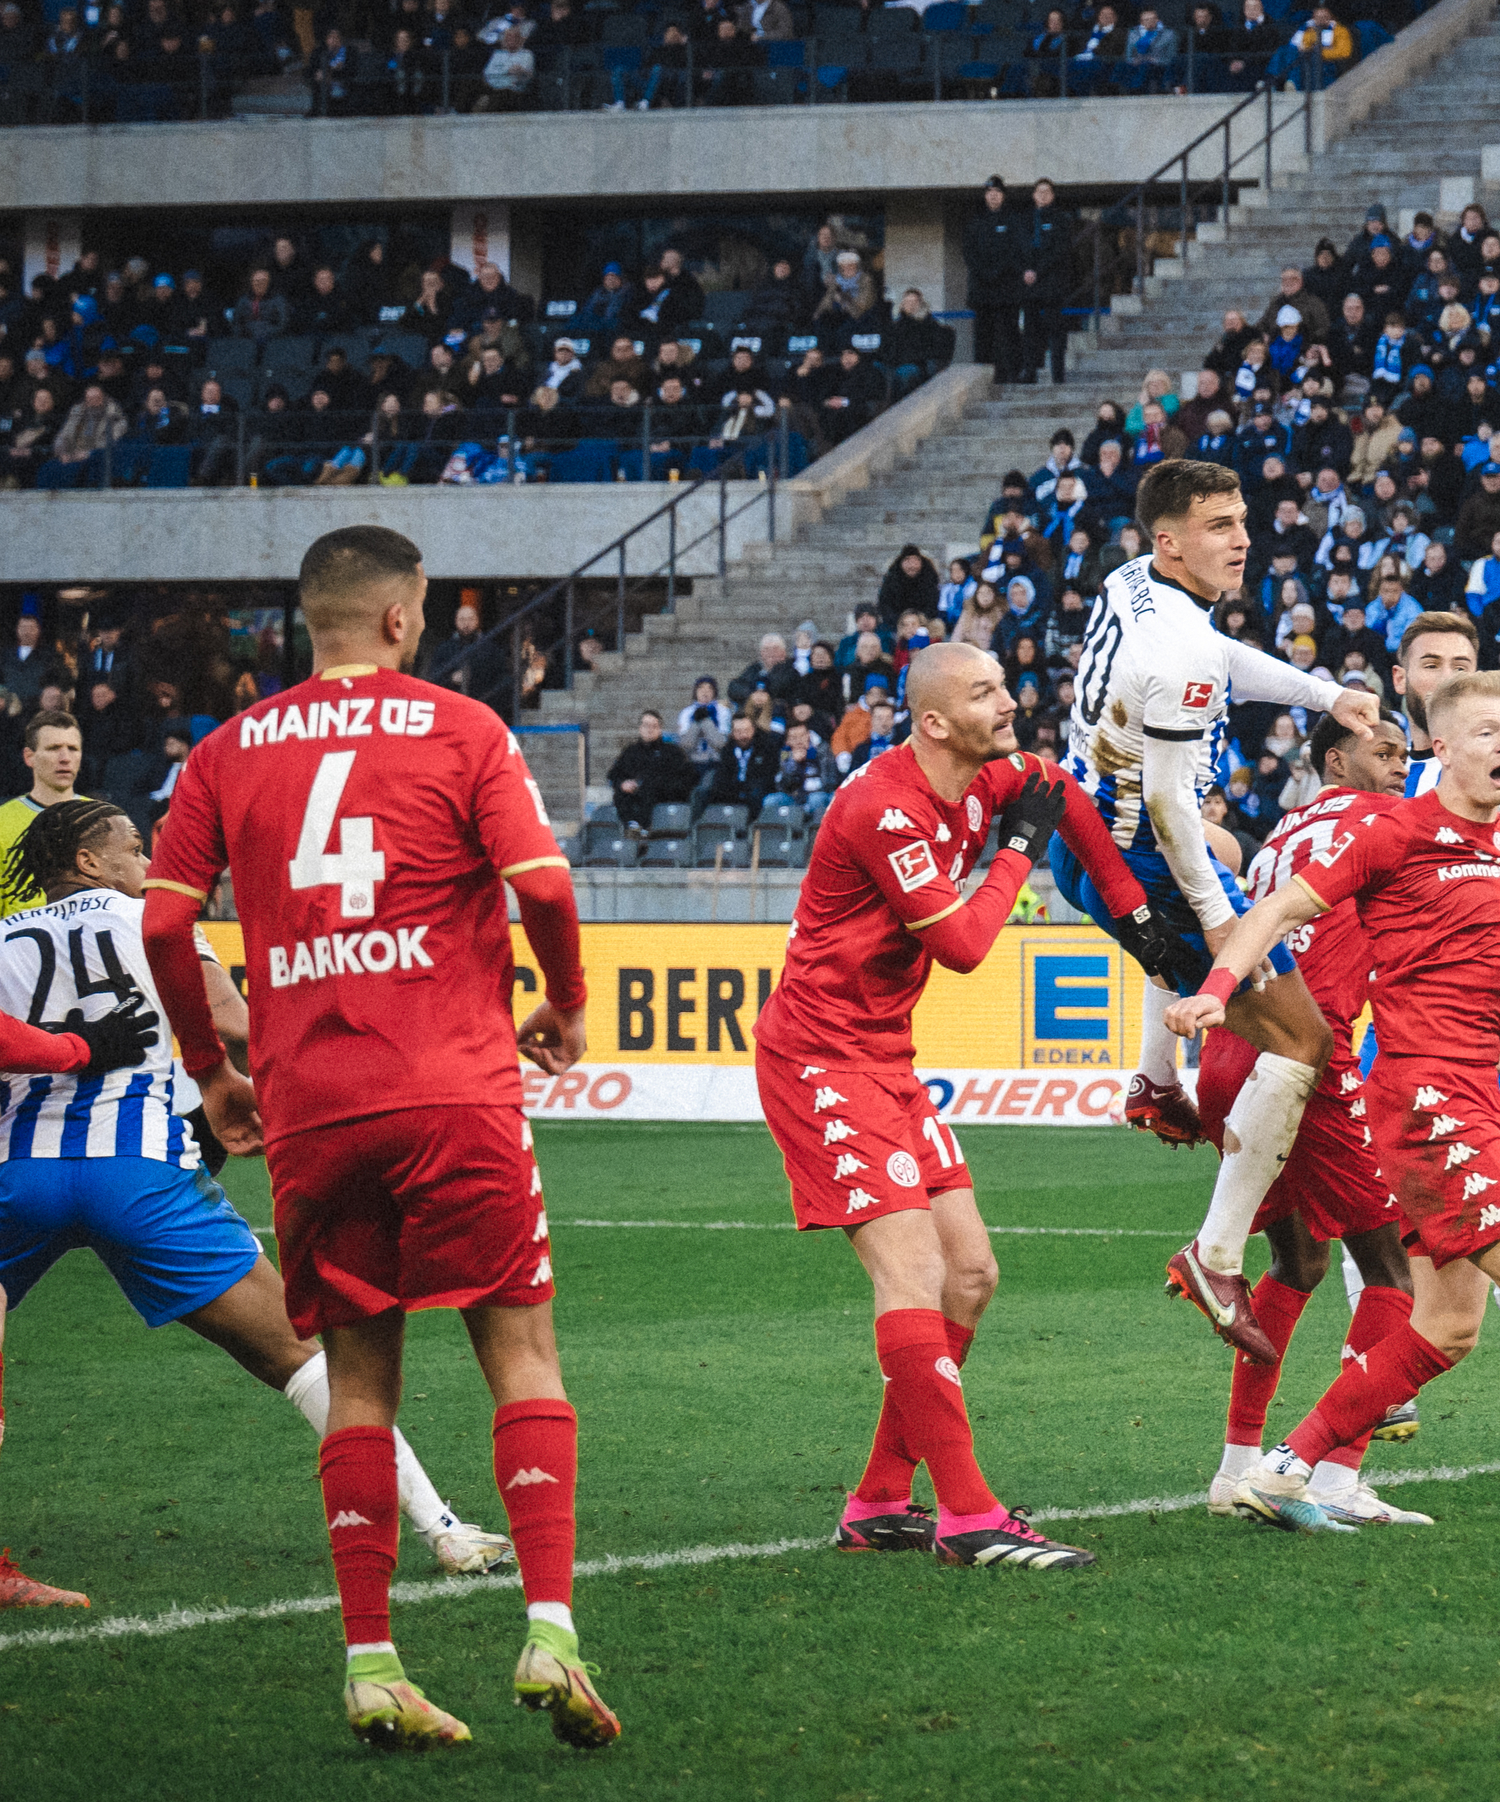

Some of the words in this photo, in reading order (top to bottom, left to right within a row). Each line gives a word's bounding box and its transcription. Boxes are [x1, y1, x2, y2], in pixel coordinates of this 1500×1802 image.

[1130, 587, 1156, 623] BSC
[240, 698, 375, 750] MAINZ
[379, 698, 436, 737] 05
[288, 750, 386, 918] 4
[79, 895, 118, 913] BSC
[4, 925, 137, 1026] 24
[269, 925, 435, 989] BARKOK
[1033, 1048, 1112, 1065] EDEKA
